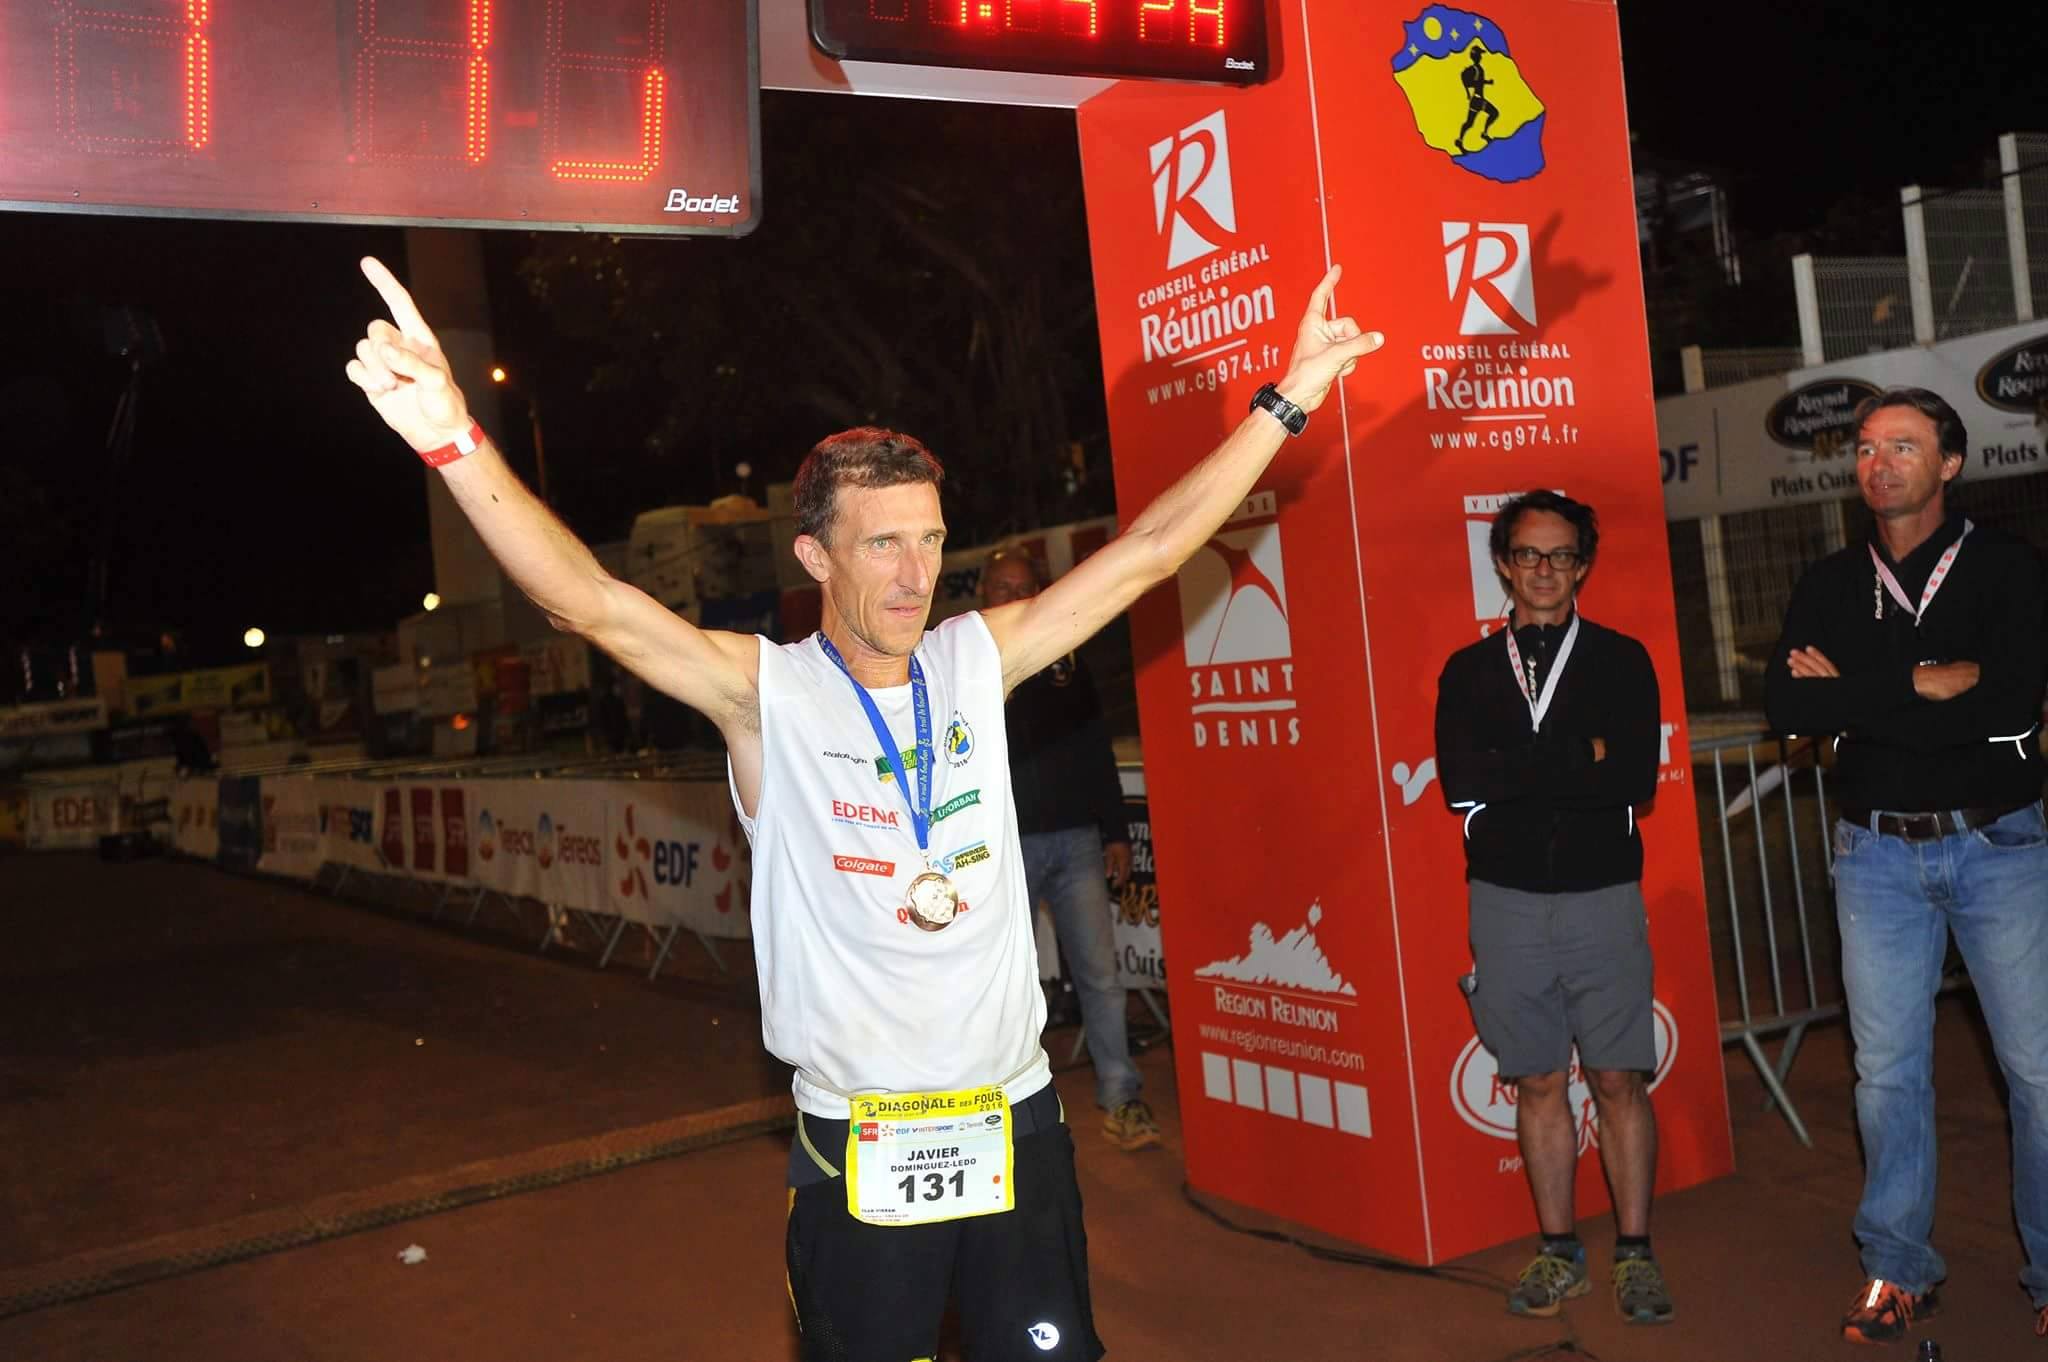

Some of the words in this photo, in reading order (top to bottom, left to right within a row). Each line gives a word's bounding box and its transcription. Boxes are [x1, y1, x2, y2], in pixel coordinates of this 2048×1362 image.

[664, 189, 740, 215] Bodet
[1138, 274, 1196, 309] CONSEIL
[1201, 243, 1270, 284] GÉNÉRAL
[1181, 294, 1198, 311] DE
[1199, 288, 1216, 304] LA
[1140, 285, 1276, 363] Réunion
[1421, 344, 1492, 361] CONSEIL
[1500, 340, 1571, 359] GÉNÉRAL
[1147, 344, 1280, 405] www.cg974.fr
[1475, 363, 1492, 375] DE
[1496, 363, 1514, 375] LA
[1424, 366, 1576, 410] Réunion
[1430, 423, 1579, 451] www.cg974.fr
[1659, 444, 1699, 485] DF
[1983, 441, 2039, 467] Plats
[1191, 663, 1296, 698] SAINT
[1192, 716, 1301, 748] DENIS
[832, 799, 899, 827] EDENA
[836, 857, 888, 873] Colgate
[955, 851, 990, 870] AH-SING
[1199, 1023, 1365, 1071] www.regionreunion.com
[878, 1098, 955, 1113] DIAGONALE
[973, 1091, 1003, 1105] FOUS
[979, 1102, 1003, 1112] 2016
[861, 1127, 878, 1136] SFR
[890, 1158, 977, 1172] DOMINGUEZ-LEDO
[907, 1147, 960, 1161] JAVIER
[898, 1169, 965, 1203] 131
